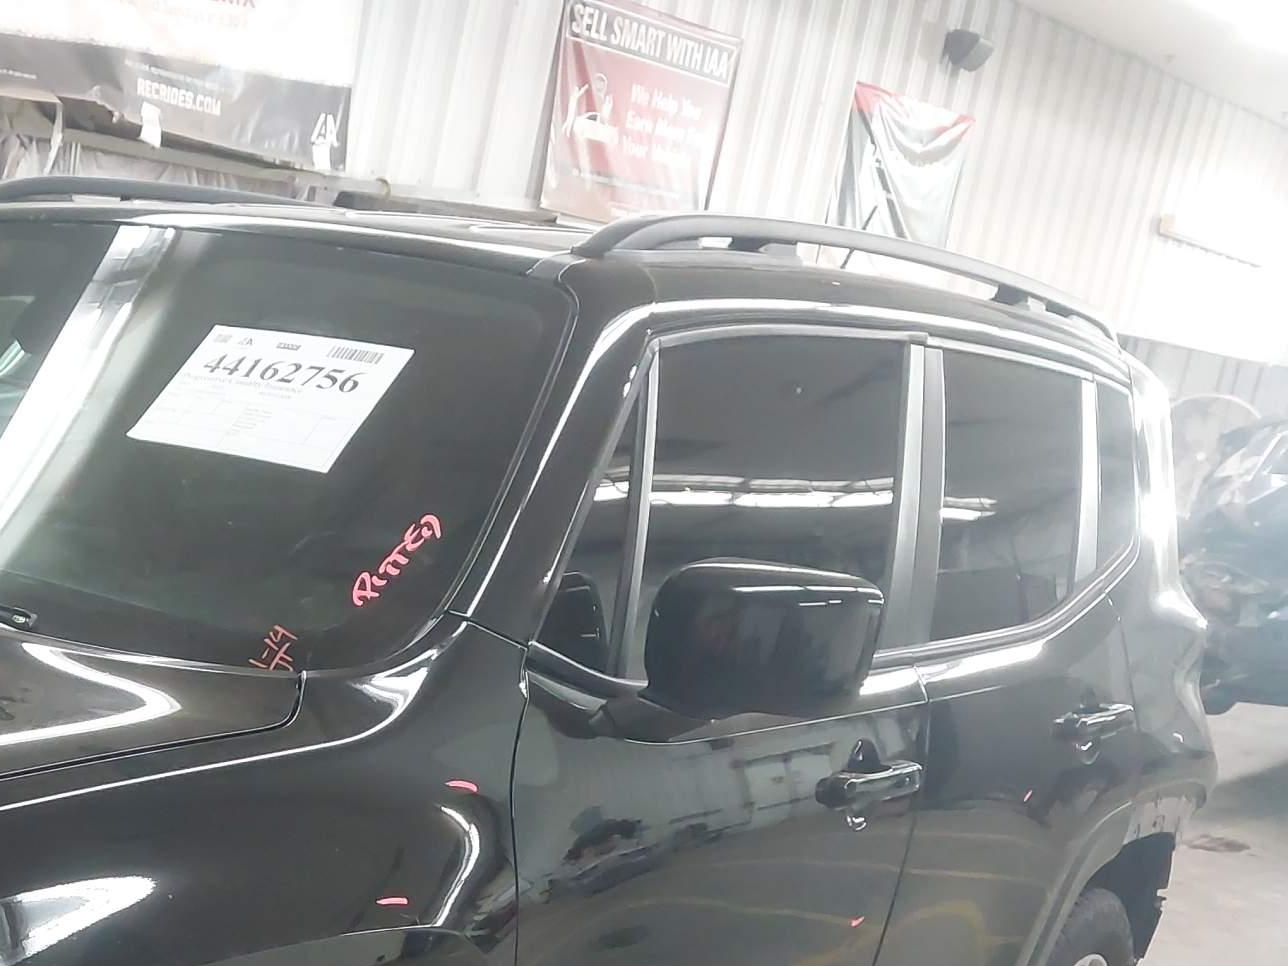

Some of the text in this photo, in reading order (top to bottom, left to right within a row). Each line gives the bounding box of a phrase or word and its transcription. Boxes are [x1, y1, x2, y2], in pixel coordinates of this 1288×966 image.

[571, 3, 730, 79] SELL SMART WITH IAA
[136, 77, 222, 117] RECRIDES.COM
[203, 353, 368, 393] 44162756
